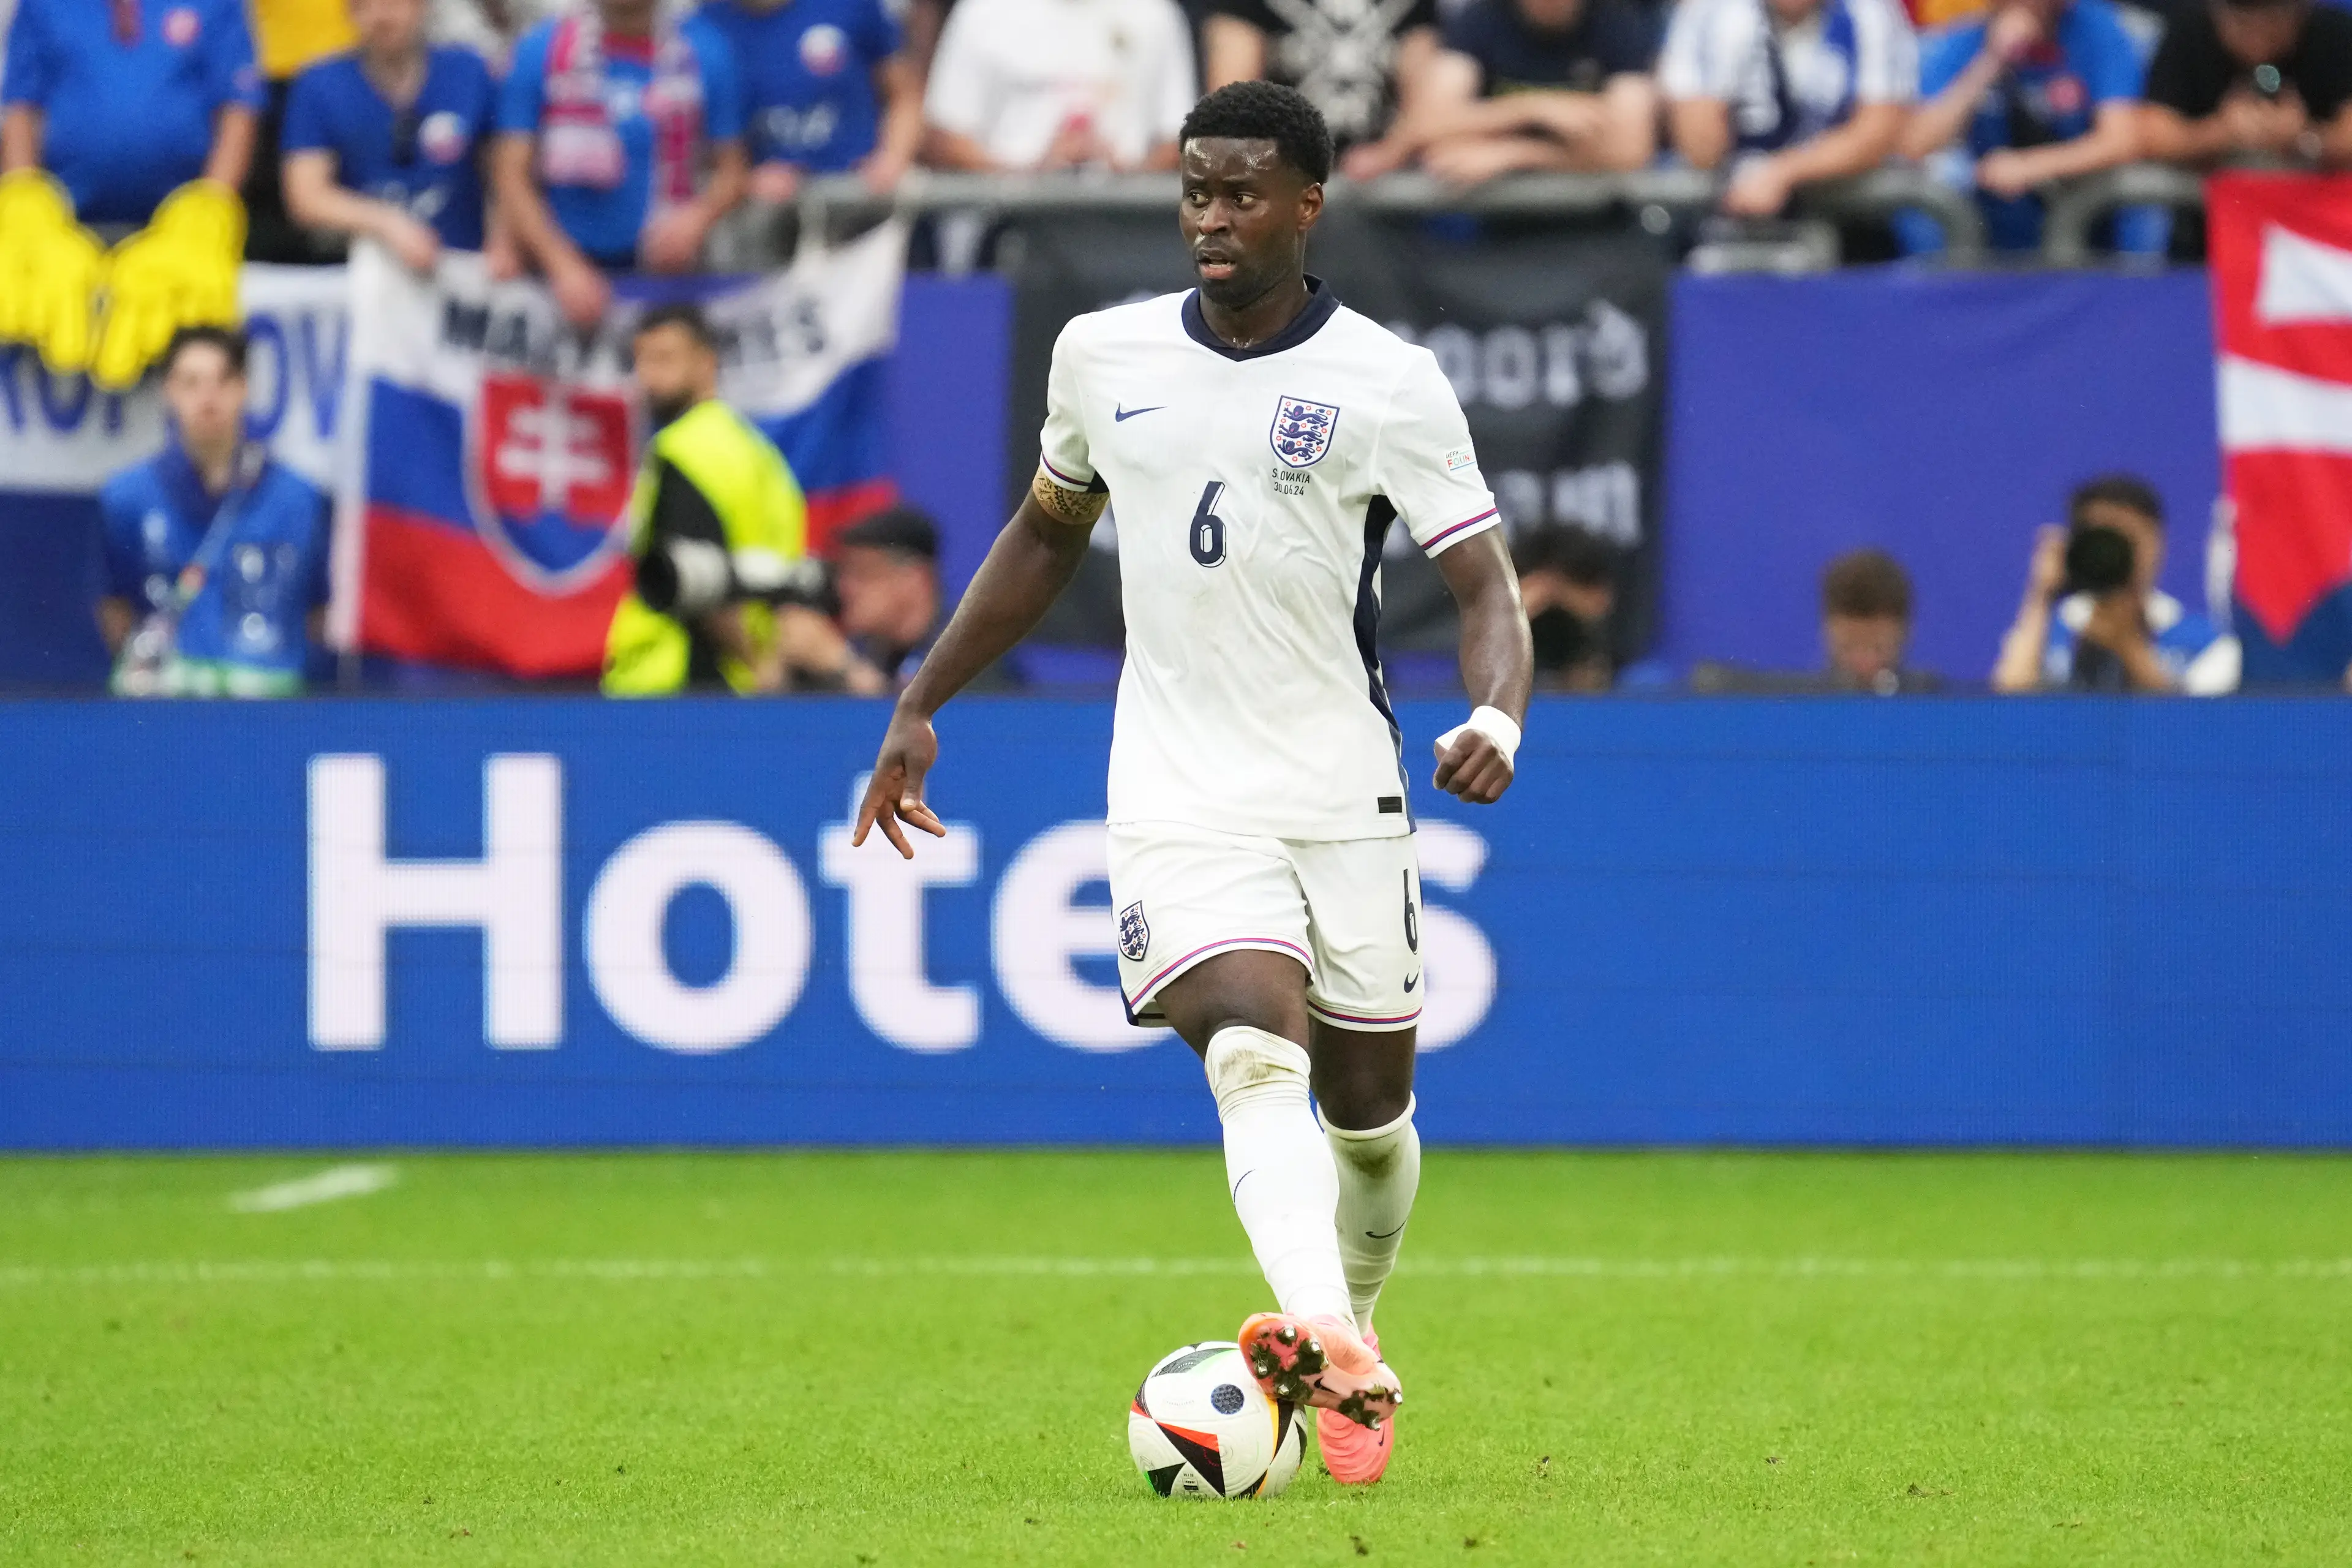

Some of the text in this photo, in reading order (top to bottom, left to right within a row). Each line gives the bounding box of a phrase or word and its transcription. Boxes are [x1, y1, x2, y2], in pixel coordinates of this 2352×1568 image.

[1190, 481, 1226, 568] 6
[1274, 481, 1304, 496] 30.06.24
[308, 752, 1498, 1052] Hotes
[1403, 868, 1418, 956] 6
